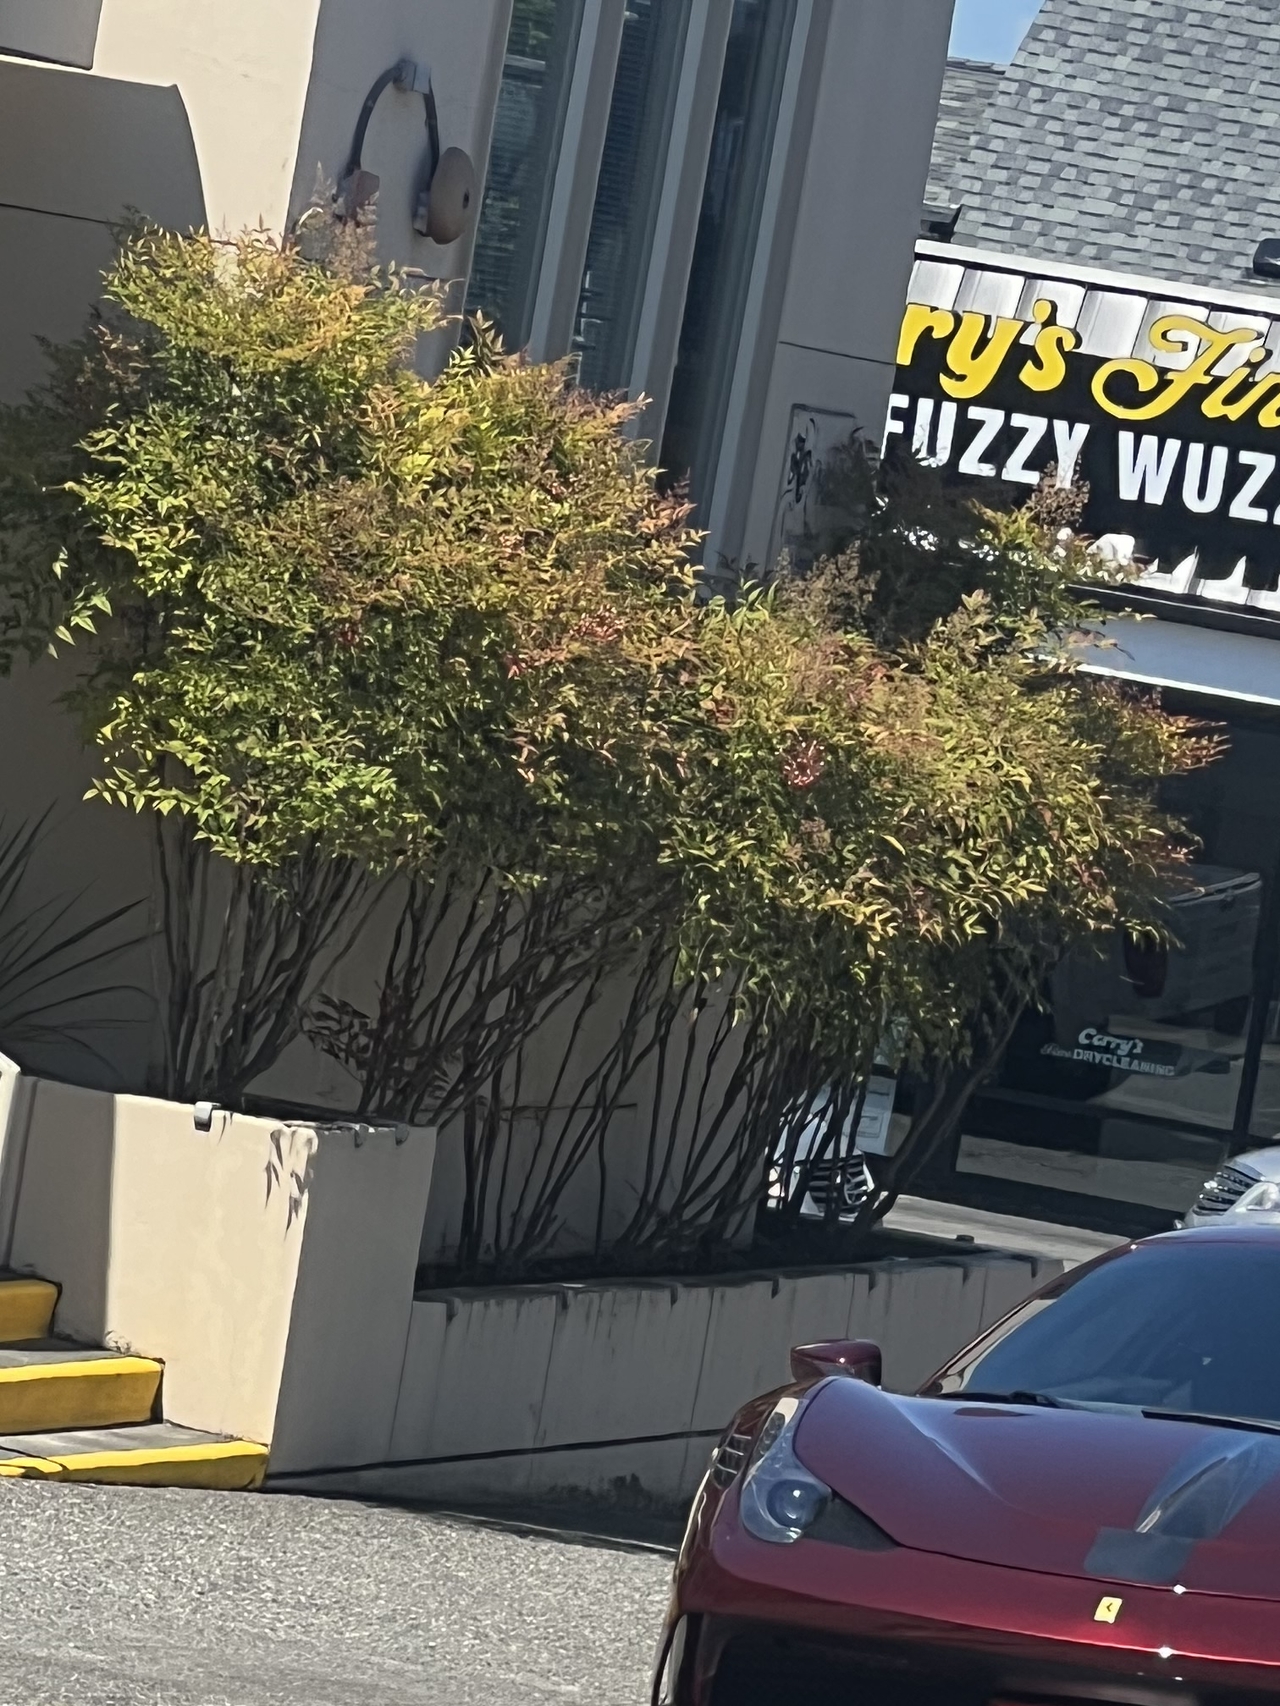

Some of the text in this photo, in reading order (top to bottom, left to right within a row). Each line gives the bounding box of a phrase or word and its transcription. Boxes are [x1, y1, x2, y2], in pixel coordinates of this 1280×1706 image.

[896, 299, 1076, 399] ry's
[880, 393, 1090, 489] FUZZY
[1073, 1048, 1175, 1076] DRYCLEANING
